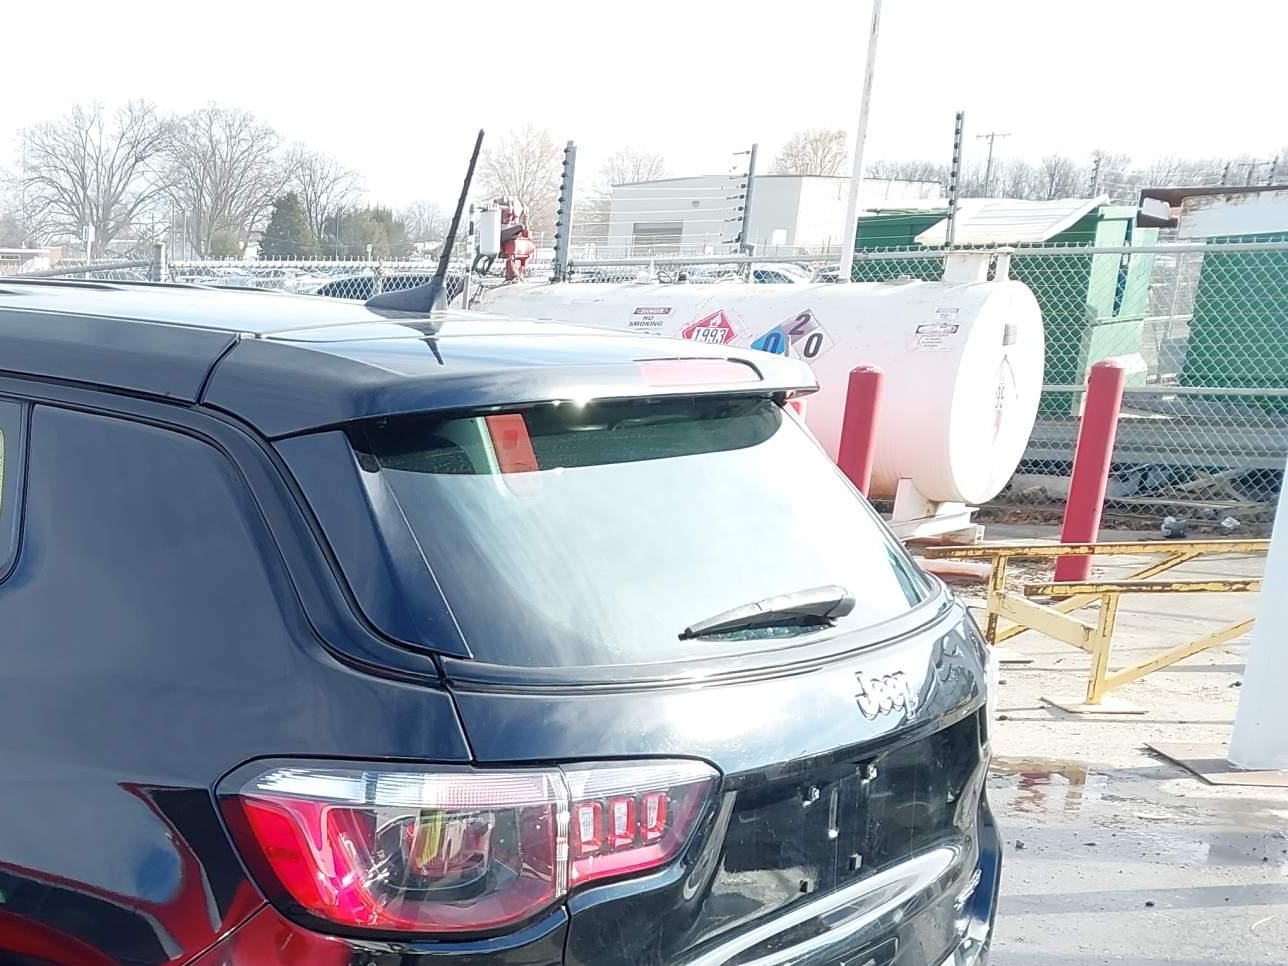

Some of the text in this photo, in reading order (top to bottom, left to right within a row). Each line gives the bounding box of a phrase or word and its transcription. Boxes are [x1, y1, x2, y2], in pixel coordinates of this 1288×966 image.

[694, 328, 727, 345] 1993
[788, 313, 811, 336] 2
[803, 332, 824, 358] 0
[854, 670, 919, 721] Jeep
